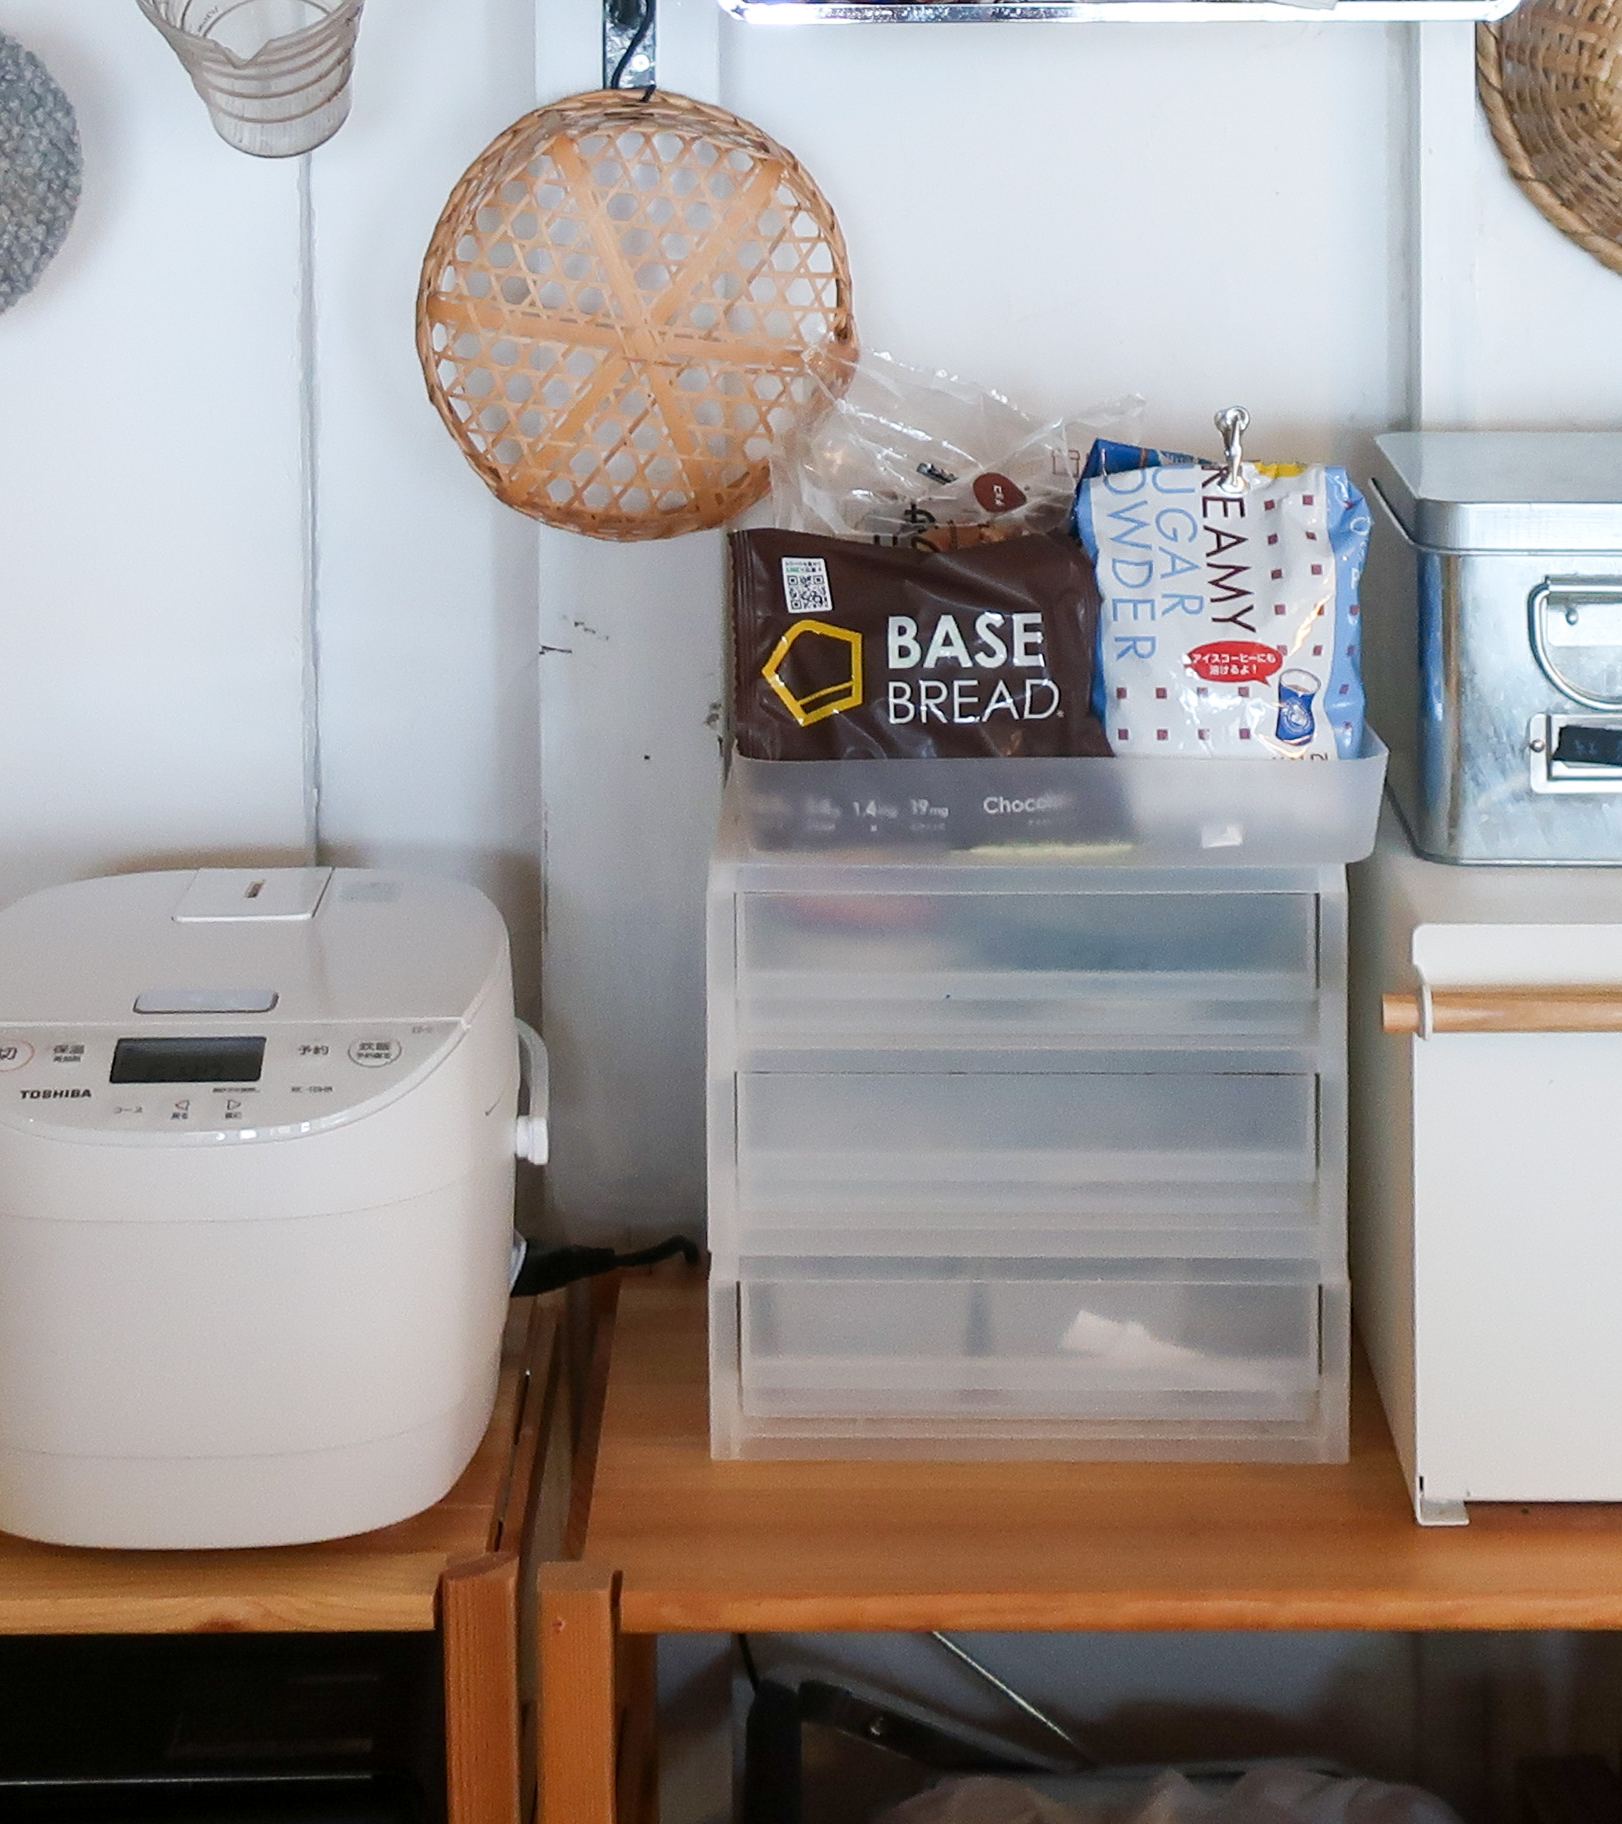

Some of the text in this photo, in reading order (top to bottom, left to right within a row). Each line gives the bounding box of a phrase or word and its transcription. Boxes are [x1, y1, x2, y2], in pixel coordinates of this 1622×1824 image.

[888, 612, 1045, 669] BASE
[1191, 653, 1277, 664] アイスコーヒーにも
[888, 678, 1060, 724] BREAD
[299, 1044, 329, 1056] 予約
[19, 1089, 92, 1100] TOSHIBA
